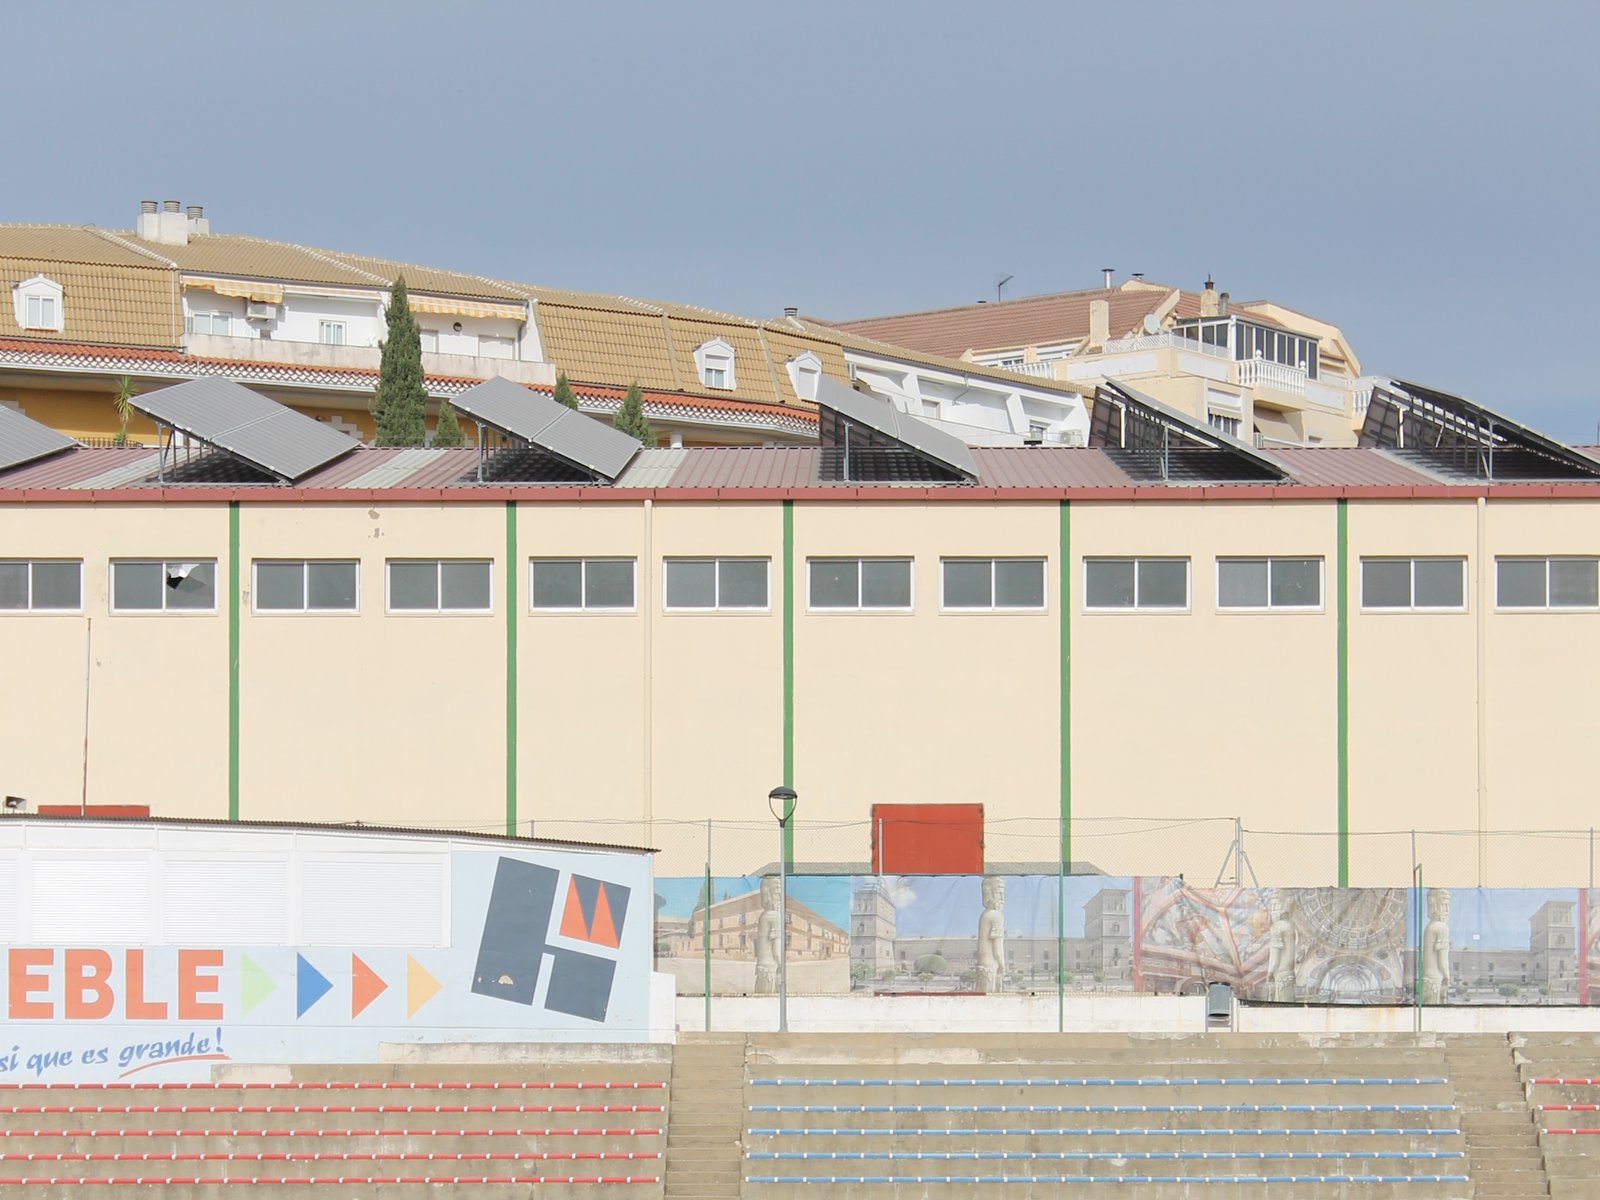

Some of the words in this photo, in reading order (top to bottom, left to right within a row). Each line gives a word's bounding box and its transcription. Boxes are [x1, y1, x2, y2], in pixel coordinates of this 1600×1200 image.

[8, 948, 224, 1020] EBLE
[26, 1050, 73, 1077] que
[81, 1046, 109, 1065] es
[118, 1027, 224, 1068] grande!
